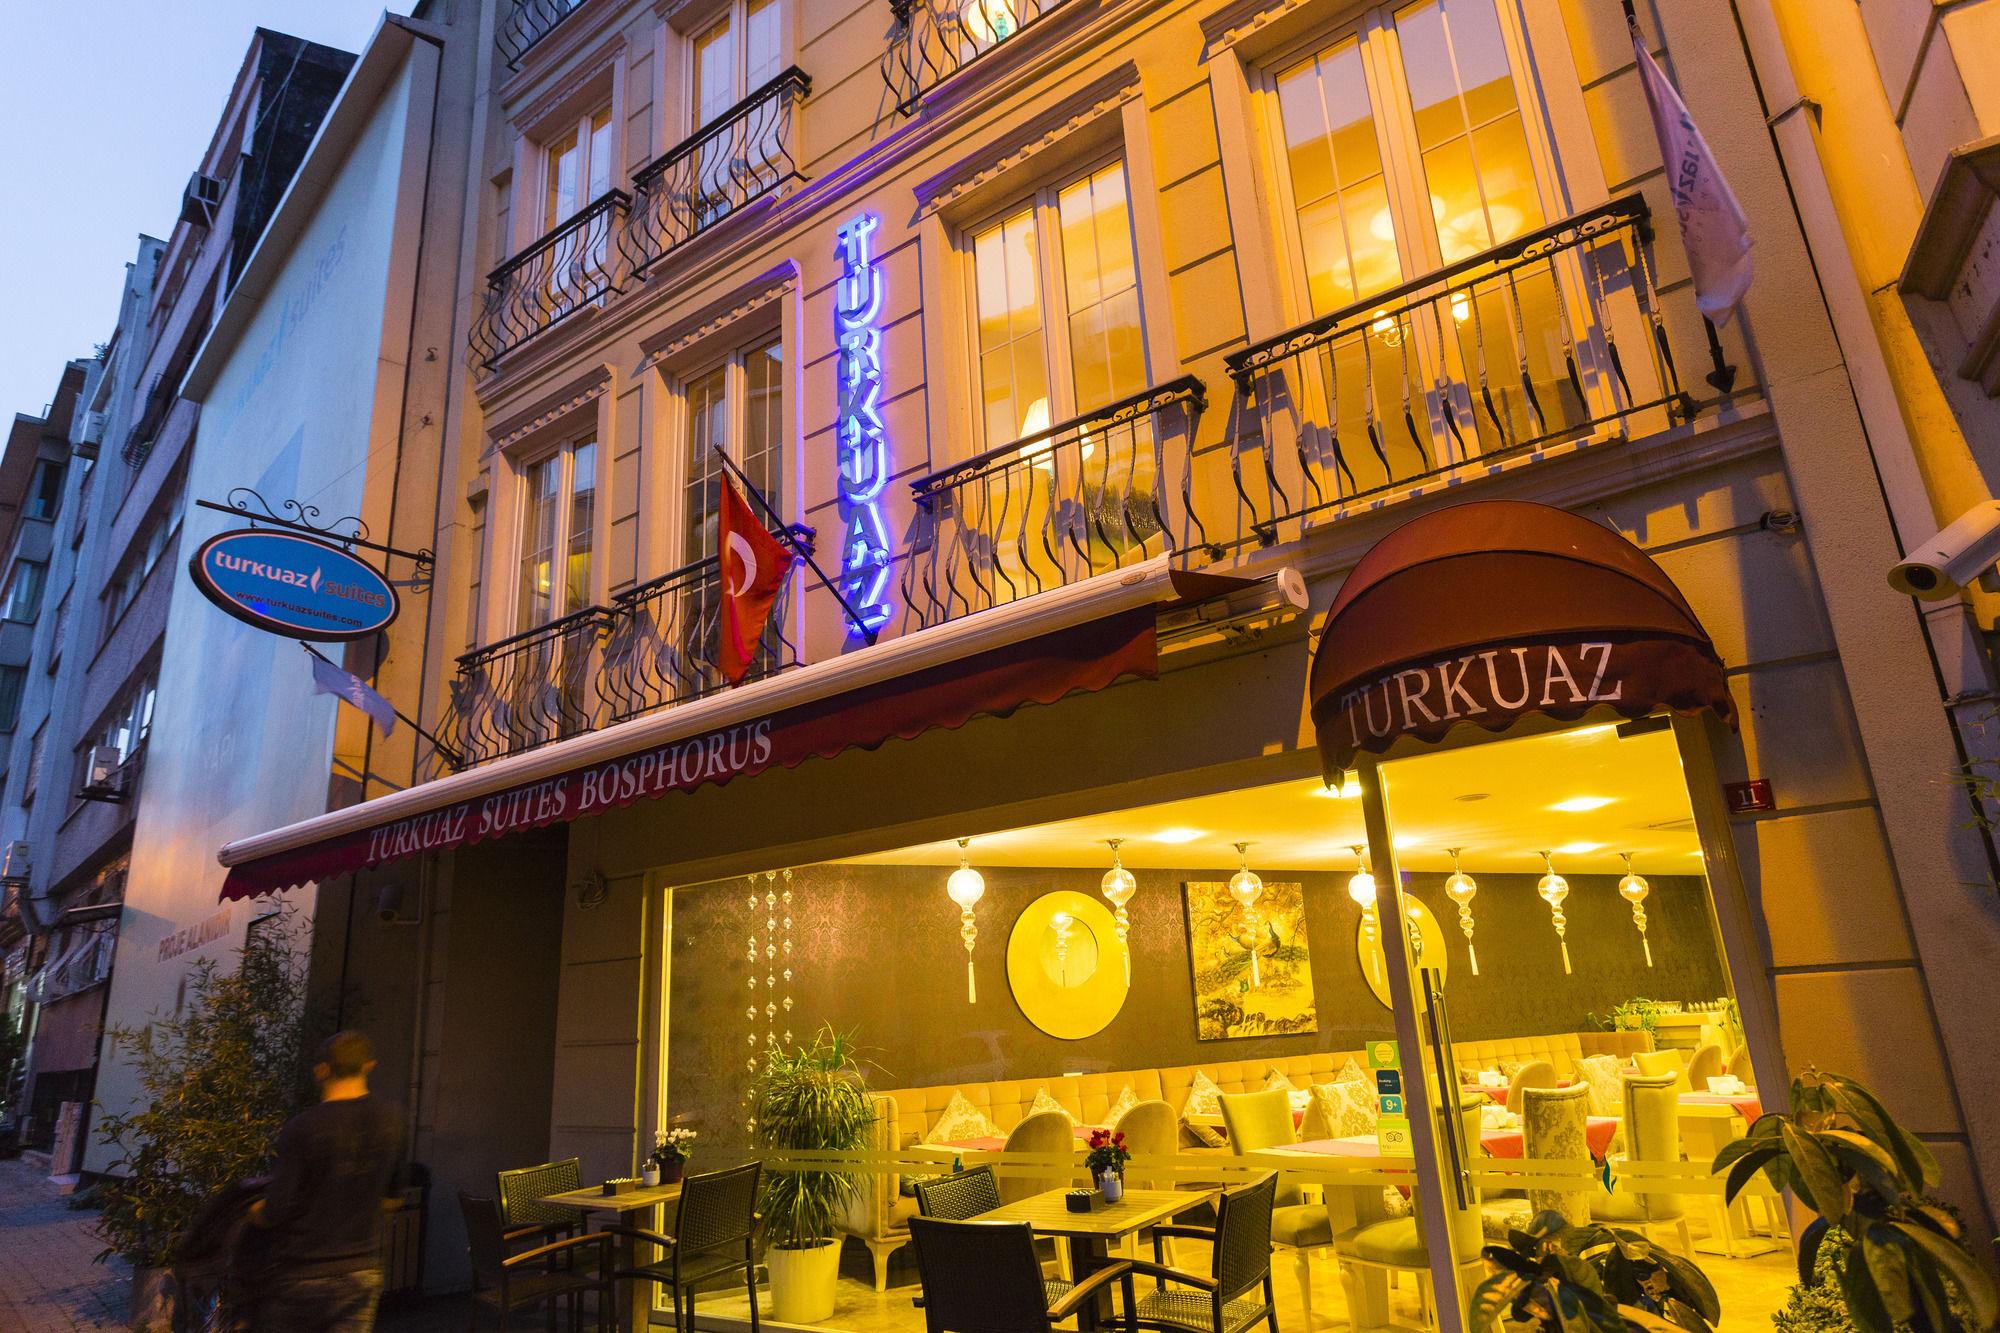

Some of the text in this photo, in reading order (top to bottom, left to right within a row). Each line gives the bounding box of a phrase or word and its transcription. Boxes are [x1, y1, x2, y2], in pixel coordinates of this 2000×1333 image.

[837, 212, 886, 631] TURKUAZ
[214, 550, 386, 608] turkuaz suites
[235, 590, 363, 627] www.turkuazsuites.com
[1340, 641, 1622, 749] TURKUAZ
[366, 718, 773, 863] TURKUAZ SUITES BOSPHORUS
[1738, 788, 1760, 806] 11
